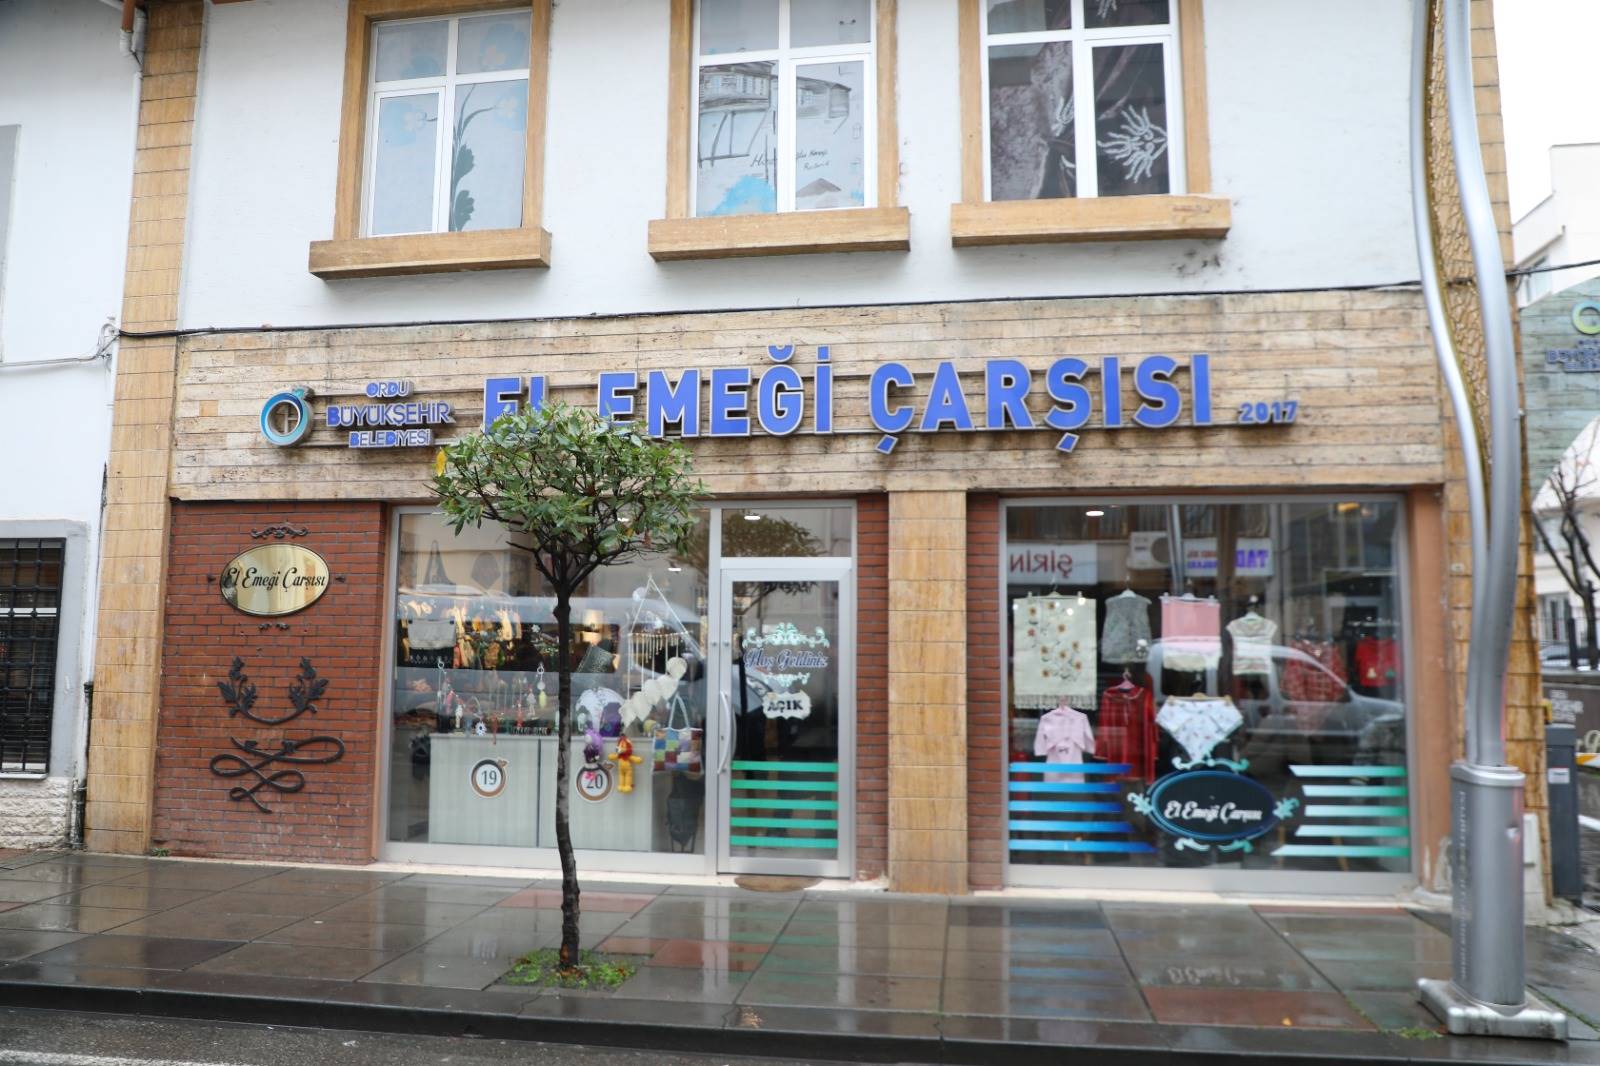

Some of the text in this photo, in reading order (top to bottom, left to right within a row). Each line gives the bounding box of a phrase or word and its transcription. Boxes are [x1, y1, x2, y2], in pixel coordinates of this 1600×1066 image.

[366, 380, 410, 398] ORDU
[598, 345, 834, 438] EMEĞİ
[868, 353, 1212, 455] ÇARŞISI
[1238, 400, 1297, 424] 2017
[326, 402, 453, 427] BÜYÜKŞEHİR
[349, 429, 432, 448] BELEDİYESİ
[223, 567, 325, 592] El Emeği Çarşısı
[767, 700, 803, 713] AÇIK
[481, 770, 498, 786] 19
